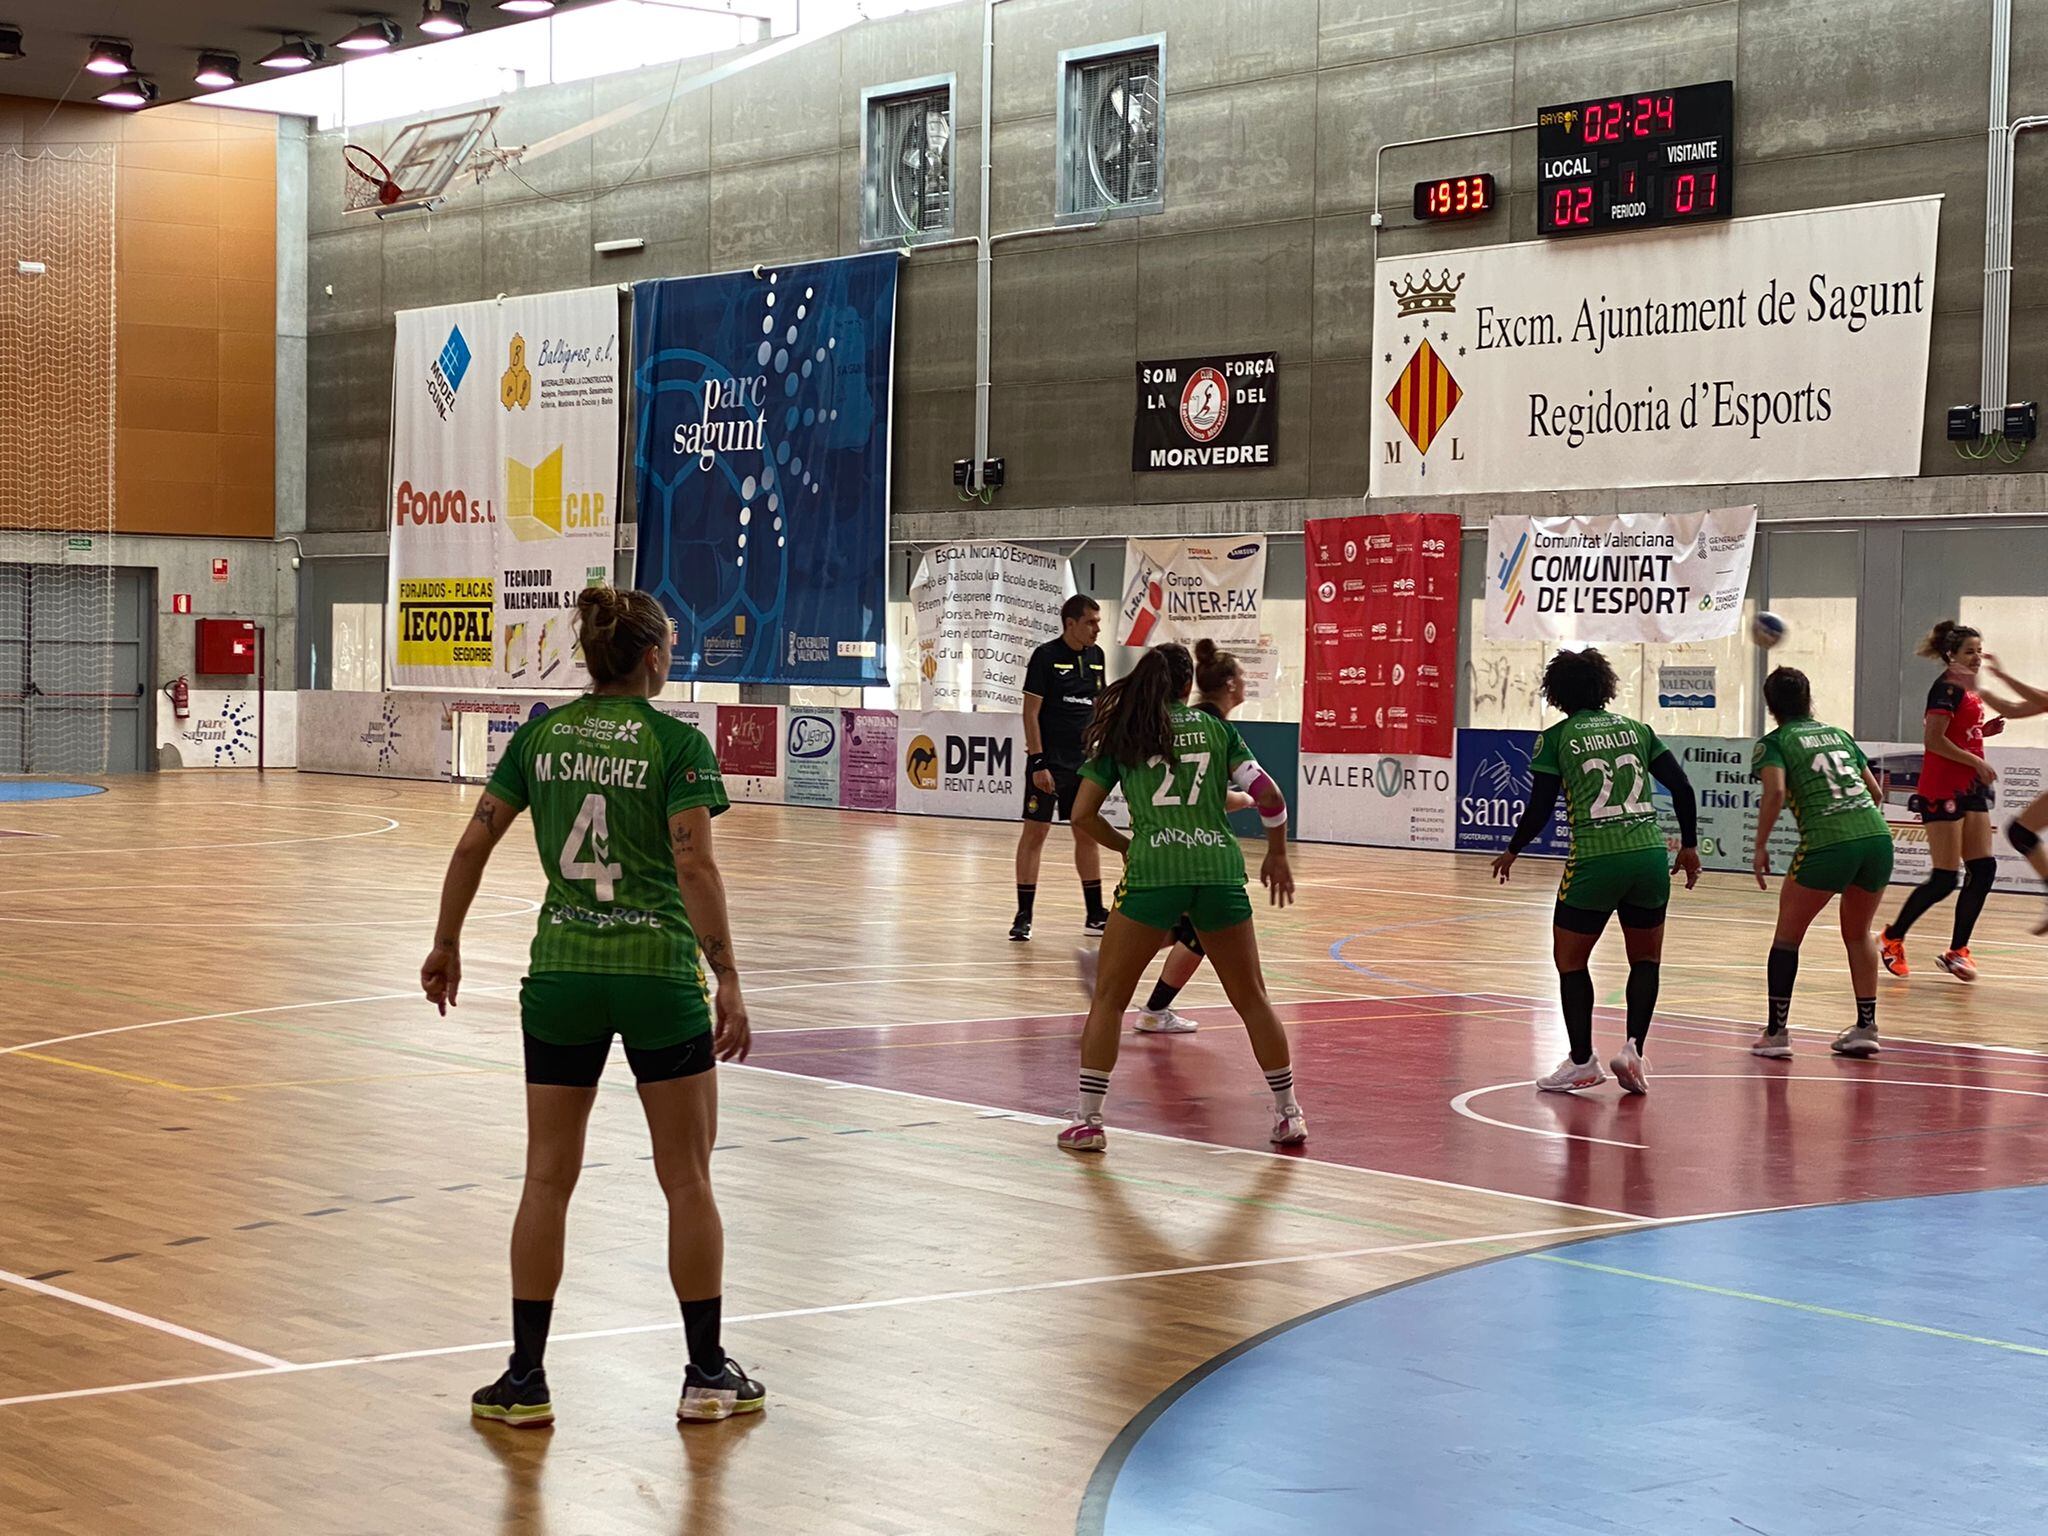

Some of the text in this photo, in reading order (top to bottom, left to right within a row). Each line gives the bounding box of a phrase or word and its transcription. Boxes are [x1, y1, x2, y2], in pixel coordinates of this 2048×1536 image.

[1667, 141, 1718, 163] VISITANTE
[1545, 157, 1591, 179] LOCAL
[1629, 171, 1635, 193] 1
[1676, 173, 1716, 213] 01
[1554, 186, 1592, 226] 02
[1611, 202, 1646, 219] PERIODO
[1475, 272, 1924, 354] Excm. Ajuntament de Sagunt
[1143, 368, 1177, 383] SOM
[1225, 358, 1275, 378] FORÇA
[431, 360, 455, 413] MODEL
[1236, 388, 1267, 404] DEL
[703, 375, 768, 426] parc
[1147, 394, 1166, 409] LA
[1528, 384, 1671, 448] Regidoria
[673, 408, 768, 472] sagunt
[1384, 437, 1464, 465] M L
[1150, 445, 1269, 467] MORVEDRE
[470, 500, 496, 524] s.l.
[566, 492, 604, 528] CAP
[1534, 532, 1674, 549] Comunitat Valenciana
[935, 548, 966, 564] ESCOLA
[1011, 547, 1057, 570] ESPORTIVA
[1531, 555, 1673, 582] COMUNITAT
[400, 582, 445, 598] FORJADOS
[455, 582, 493, 598] PLACAS
[504, 569, 552, 587] TECNODUR
[960, 570, 983, 581] Escola
[1003, 571, 1025, 586] Escola
[1027, 577, 1038, 589] de
[1040, 579, 1062, 596] Bàsqu
[1166, 572, 1202, 590] Grupo
[1168, 588, 1257, 614] INTER-FAX
[1537, 588, 1568, 612] DE
[400, 601, 493, 642] TECOPAL
[1018, 616, 1042, 630] adults
[1044, 624, 1059, 636] que
[453, 647, 492, 662] SEGORBE
[1660, 680, 1713, 690] VALENCIA
[181, 729, 227, 745] sagunt
[196, 717, 227, 741] parc
[552, 721, 614, 742] Canarias
[945, 735, 1013, 777] DFM
[560, 752, 649, 790] SANCHEZ
[1146, 752, 1211, 806] 27
[1811, 750, 1866, 800] 15
[945, 778, 1013, 794] RENT A CAR
[1582, 754, 1656, 819] 22
[559, 794, 623, 902] 4
[1150, 828, 1226, 848] LANZAROTE
